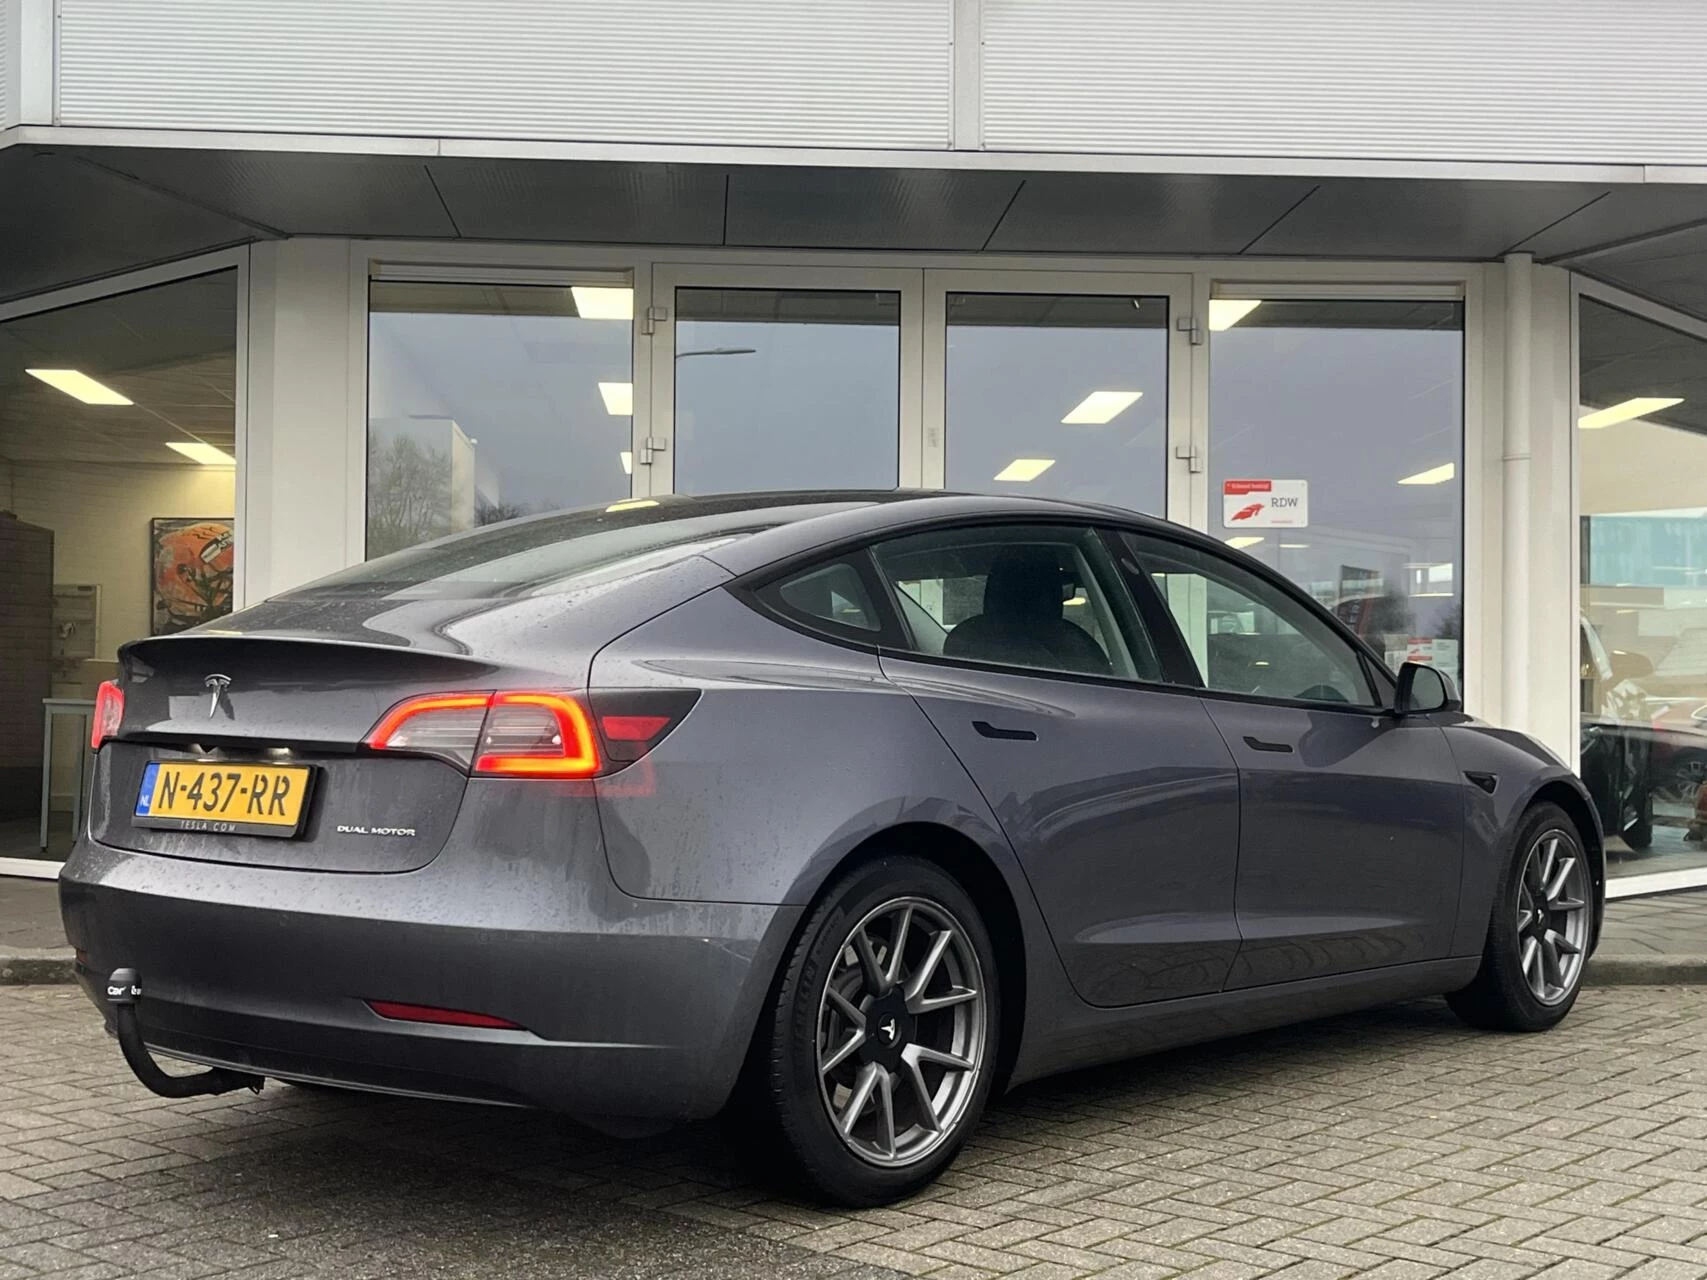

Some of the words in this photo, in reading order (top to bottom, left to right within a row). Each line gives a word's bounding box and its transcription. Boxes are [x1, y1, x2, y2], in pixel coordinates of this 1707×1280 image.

[1271, 497, 1299, 508] RDW
[157, 770, 291, 817] N-437-RR
[140, 794, 150, 806] NL
[336, 825, 369, 834] DUAL
[370, 827, 416, 837] MOTOR
[107, 985, 127, 995] Car
